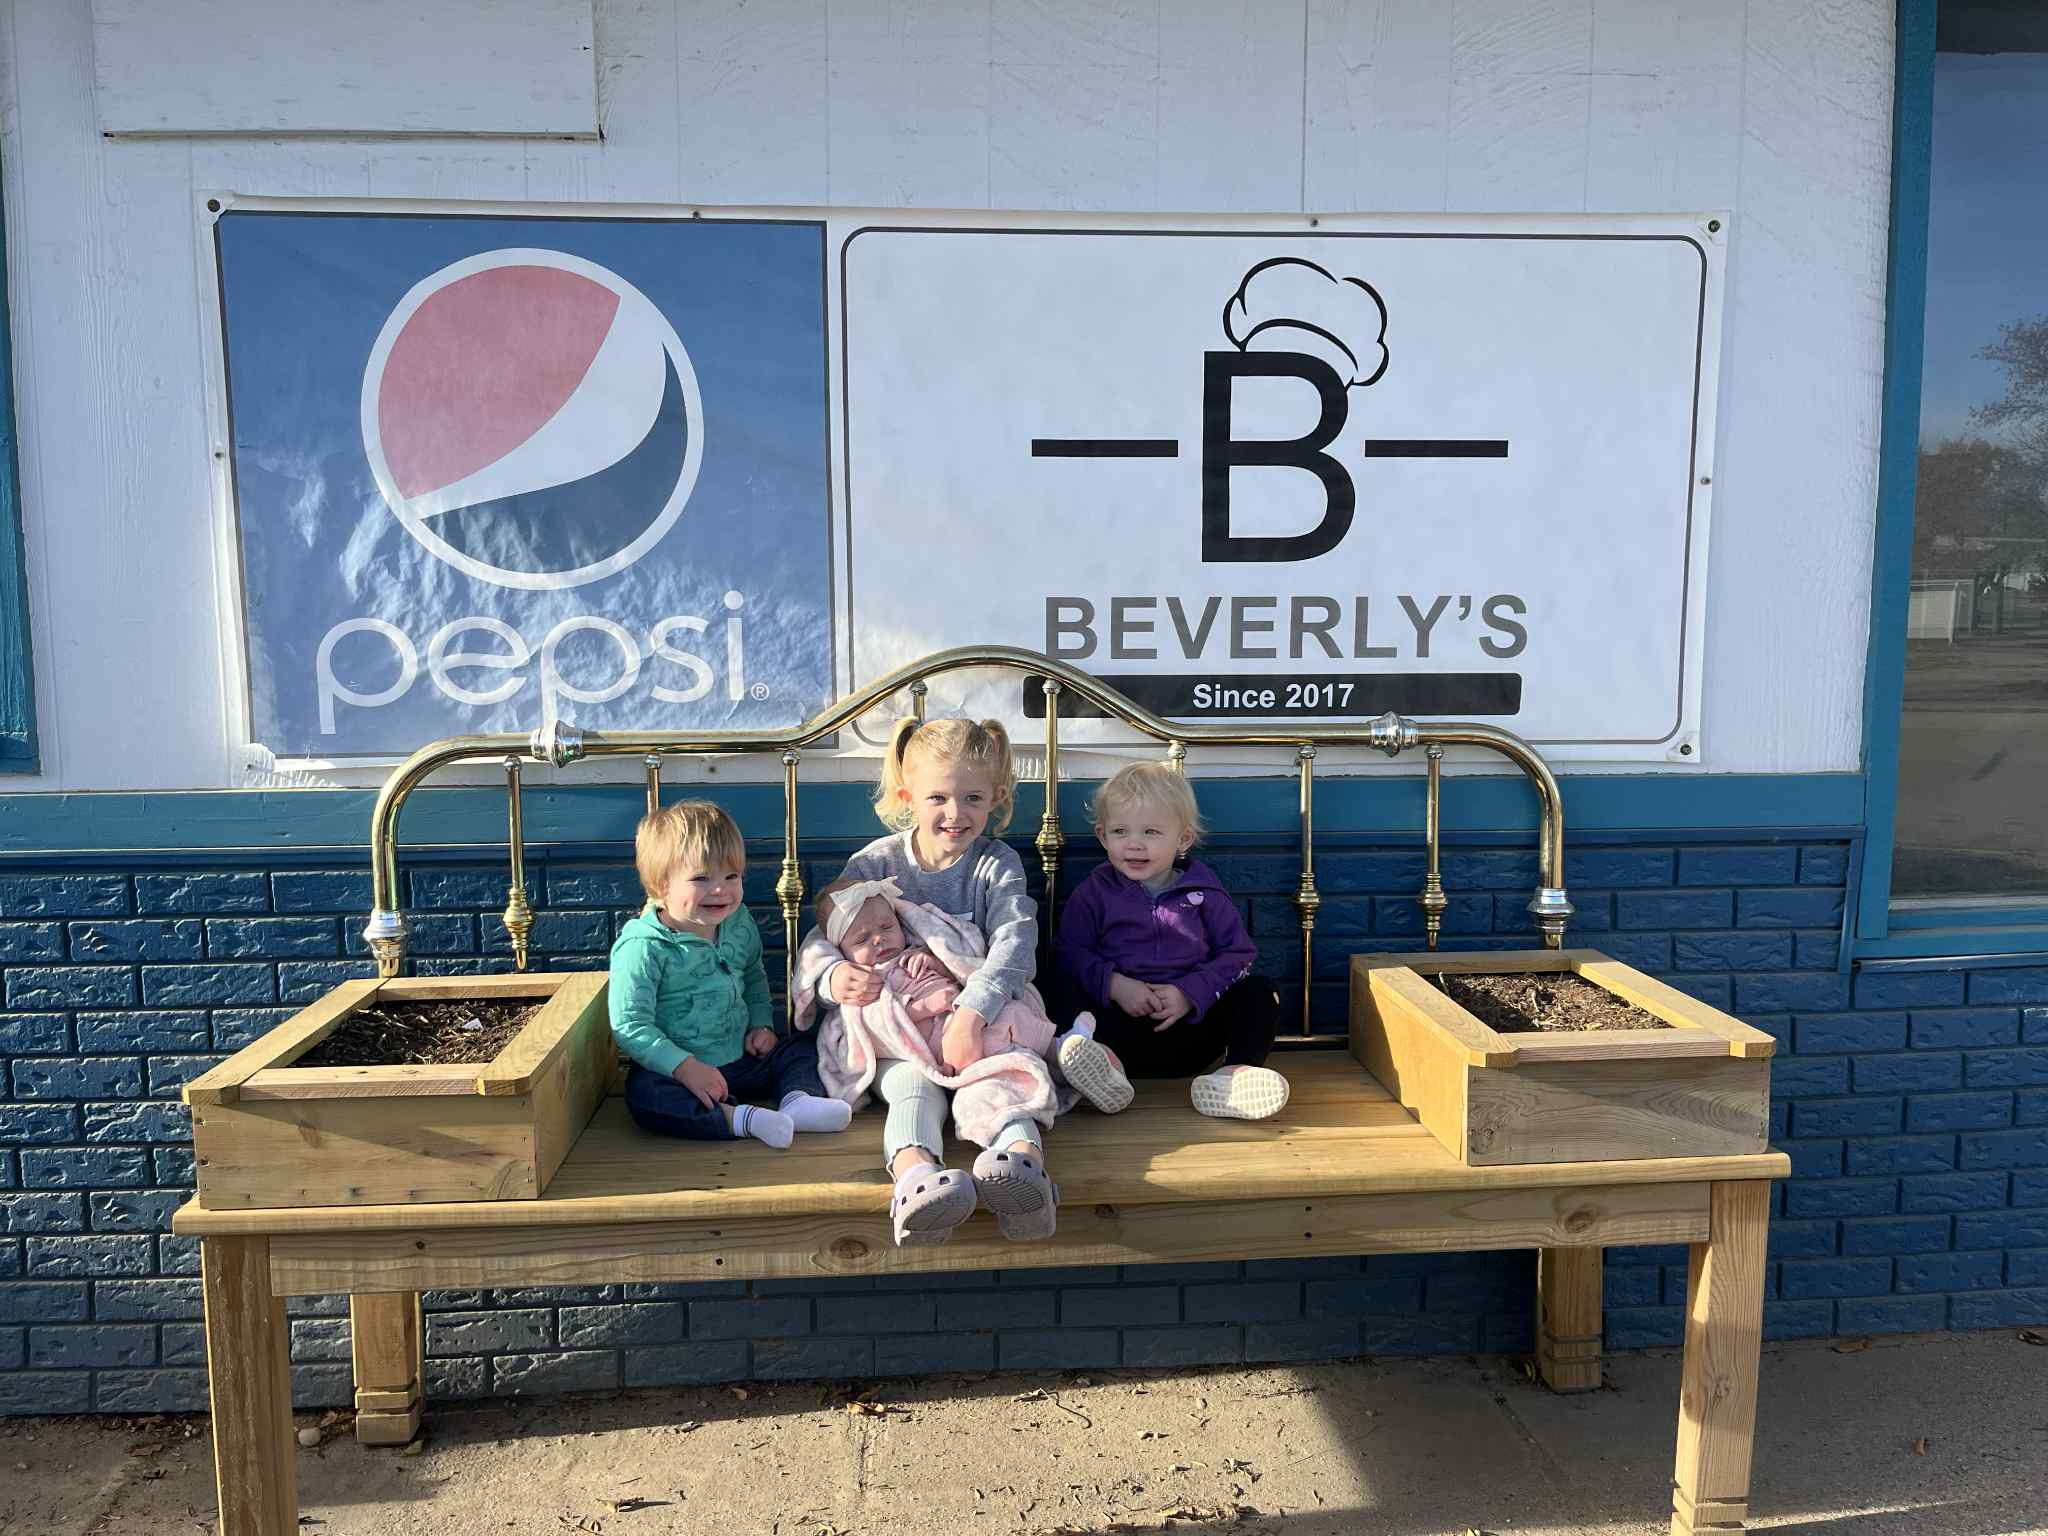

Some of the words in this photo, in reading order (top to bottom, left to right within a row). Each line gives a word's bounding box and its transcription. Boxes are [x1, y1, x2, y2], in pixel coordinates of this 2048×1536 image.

[1201, 350, 1356, 563] B
[316, 590, 744, 735] pepsi
[1044, 595, 1529, 660] BEVERLY'S
[1192, 683, 1276, 710] Since
[1284, 683, 1355, 709] 2017
